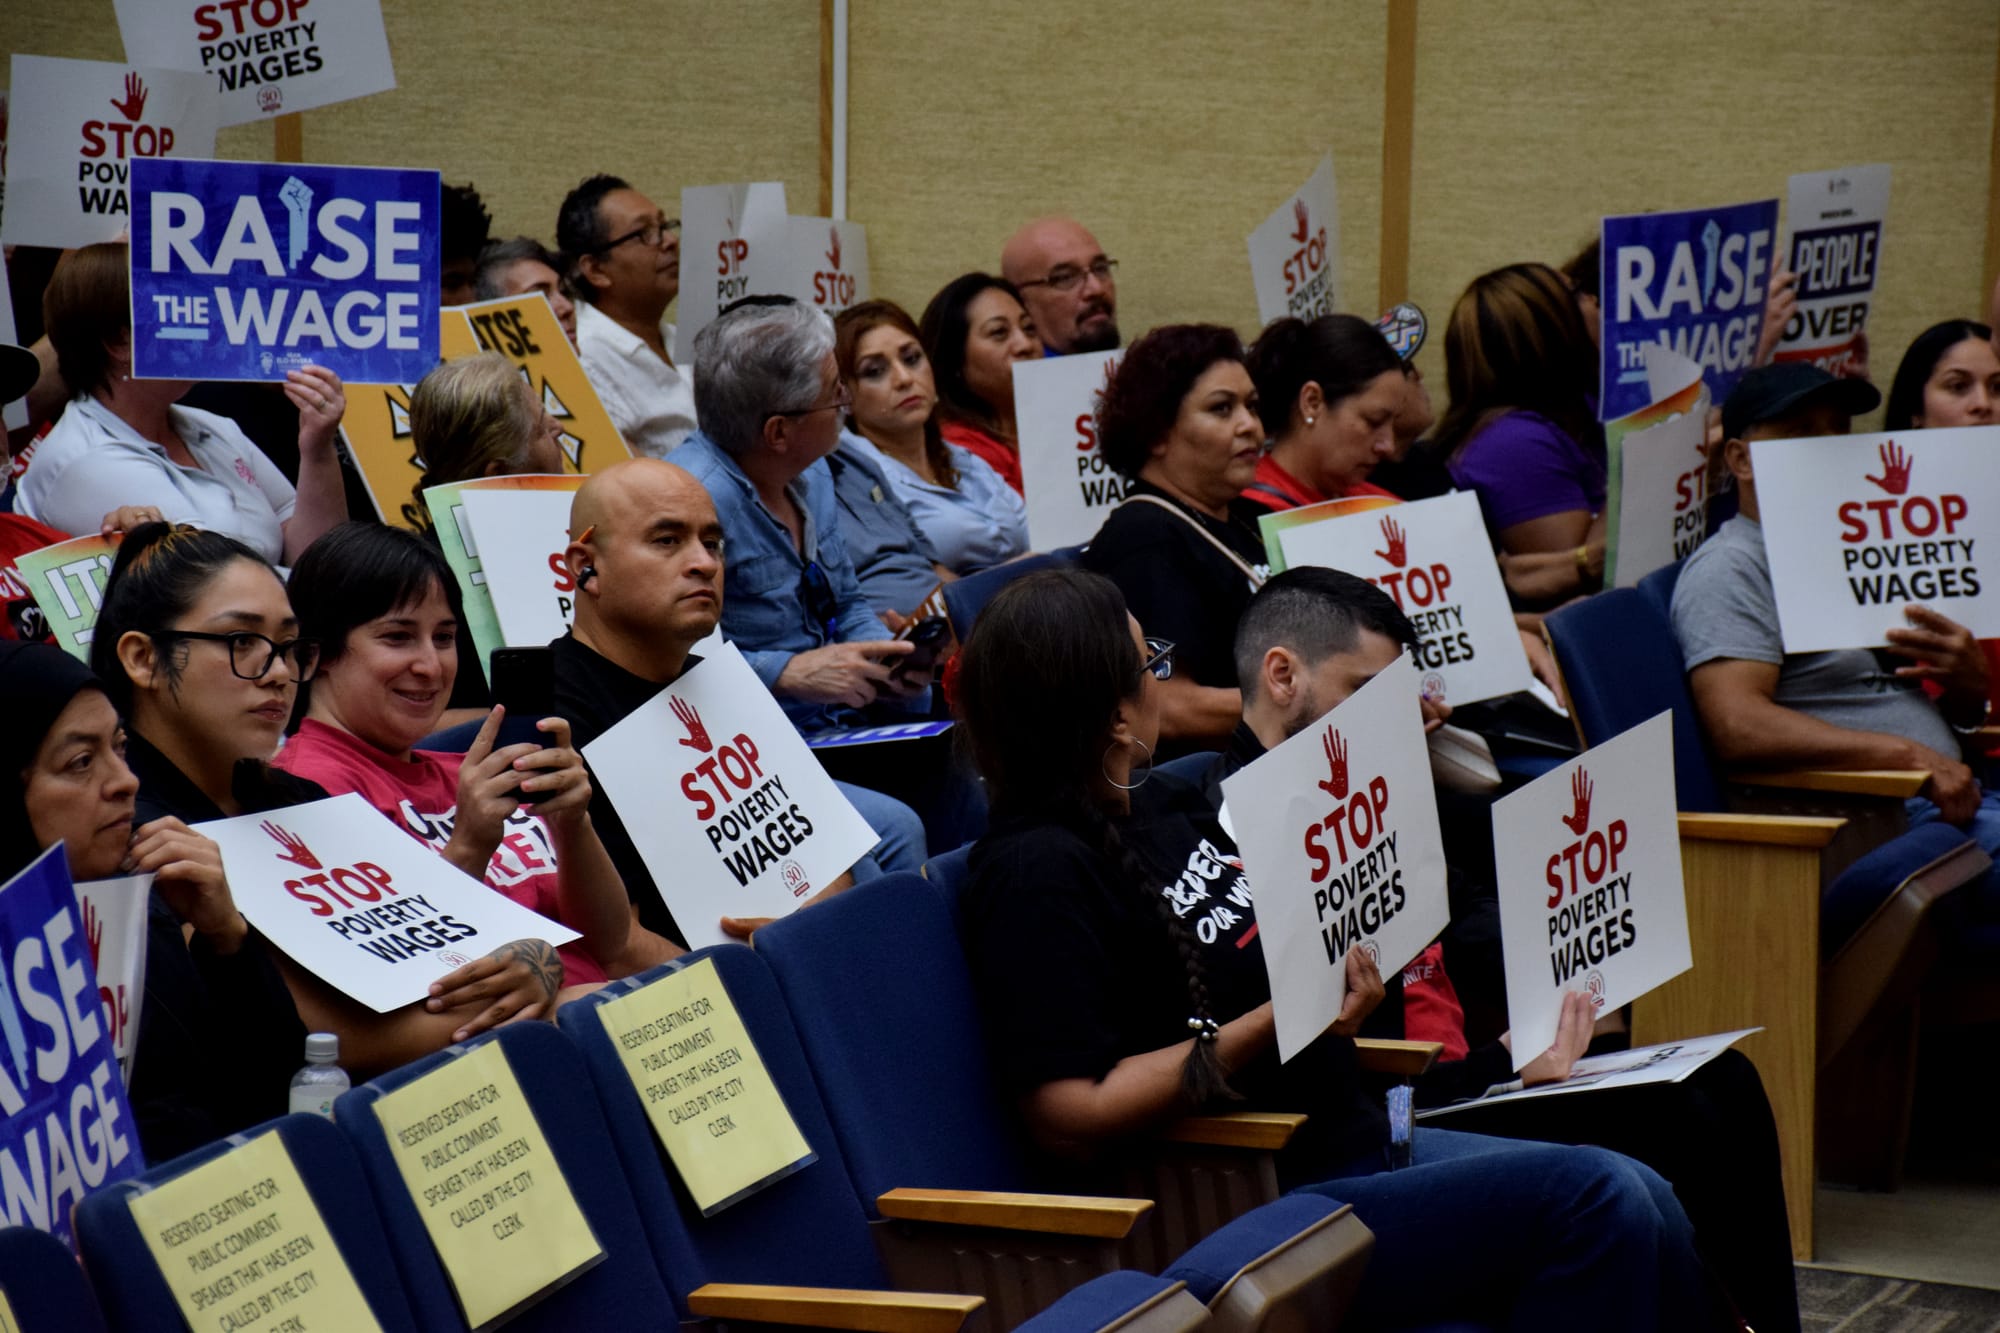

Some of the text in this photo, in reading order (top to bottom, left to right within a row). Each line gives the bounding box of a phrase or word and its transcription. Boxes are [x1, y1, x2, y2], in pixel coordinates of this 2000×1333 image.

[201, 21, 316, 66] POVERTY
[80, 120, 174, 159] STOP
[150, 188, 421, 282] RAISE
[1796, 232, 1877, 292] PEOPLE
[1616, 229, 1770, 323] RAISE
[152, 287, 420, 350] THE WAGE
[1781, 302, 1868, 343] OVER
[1616, 341, 1648, 369] TH
[1838, 494, 1967, 543] STOP
[1843, 539, 1975, 571] POVERTY
[1366, 563, 1451, 612] TOP
[1848, 567, 1981, 605] WAGES
[680, 733, 764, 821] STOP
[705, 774, 789, 853] POVERTY
[1304, 776, 1389, 883] STOP
[722, 804, 814, 888] WAGES
[1545, 818, 1628, 909] STOP
[283, 862, 399, 916] STOP
[786, 866, 802, 886] 30
[1313, 830, 1399, 923] POVERTY
[327, 894, 440, 940] POVERTY
[1197, 906, 1243, 944] OUR
[1321, 869, 1406, 967] WAGES
[1548, 872, 1632, 947] POVERTY
[357, 914, 479, 964] WAGES
[1550, 908, 1637, 988] WAGES
[619, 997, 714, 1051] RESERVED SEATING FOR
[641, 1027, 716, 1072] PUBLIC COMMENT
[645, 1047, 743, 1104] SPEAKER THAT HAS BEEN
[668, 1076, 745, 1125] CALLED BY THE CITY
[397, 1083, 501, 1149] RESERVED SEATING FOR
[421, 1116, 503, 1173] PUBLIC COMMENT
[707, 1114, 736, 1138] CLERK
[423, 1136, 531, 1208] SPEAKER THAT HAS BEEN
[450, 1169, 535, 1229] CALLED BY THE CITY
[160, 1177, 280, 1250] RESERVED SEATING FOR
[492, 1211, 524, 1240] CLERK
[187, 1212, 283, 1274] PUBLIC COMMENT
[190, 1234, 316, 1312] SPEAKER THAT HAS BEEN
[219, 1269, 318, 1333] CALLED BY THE CITY
